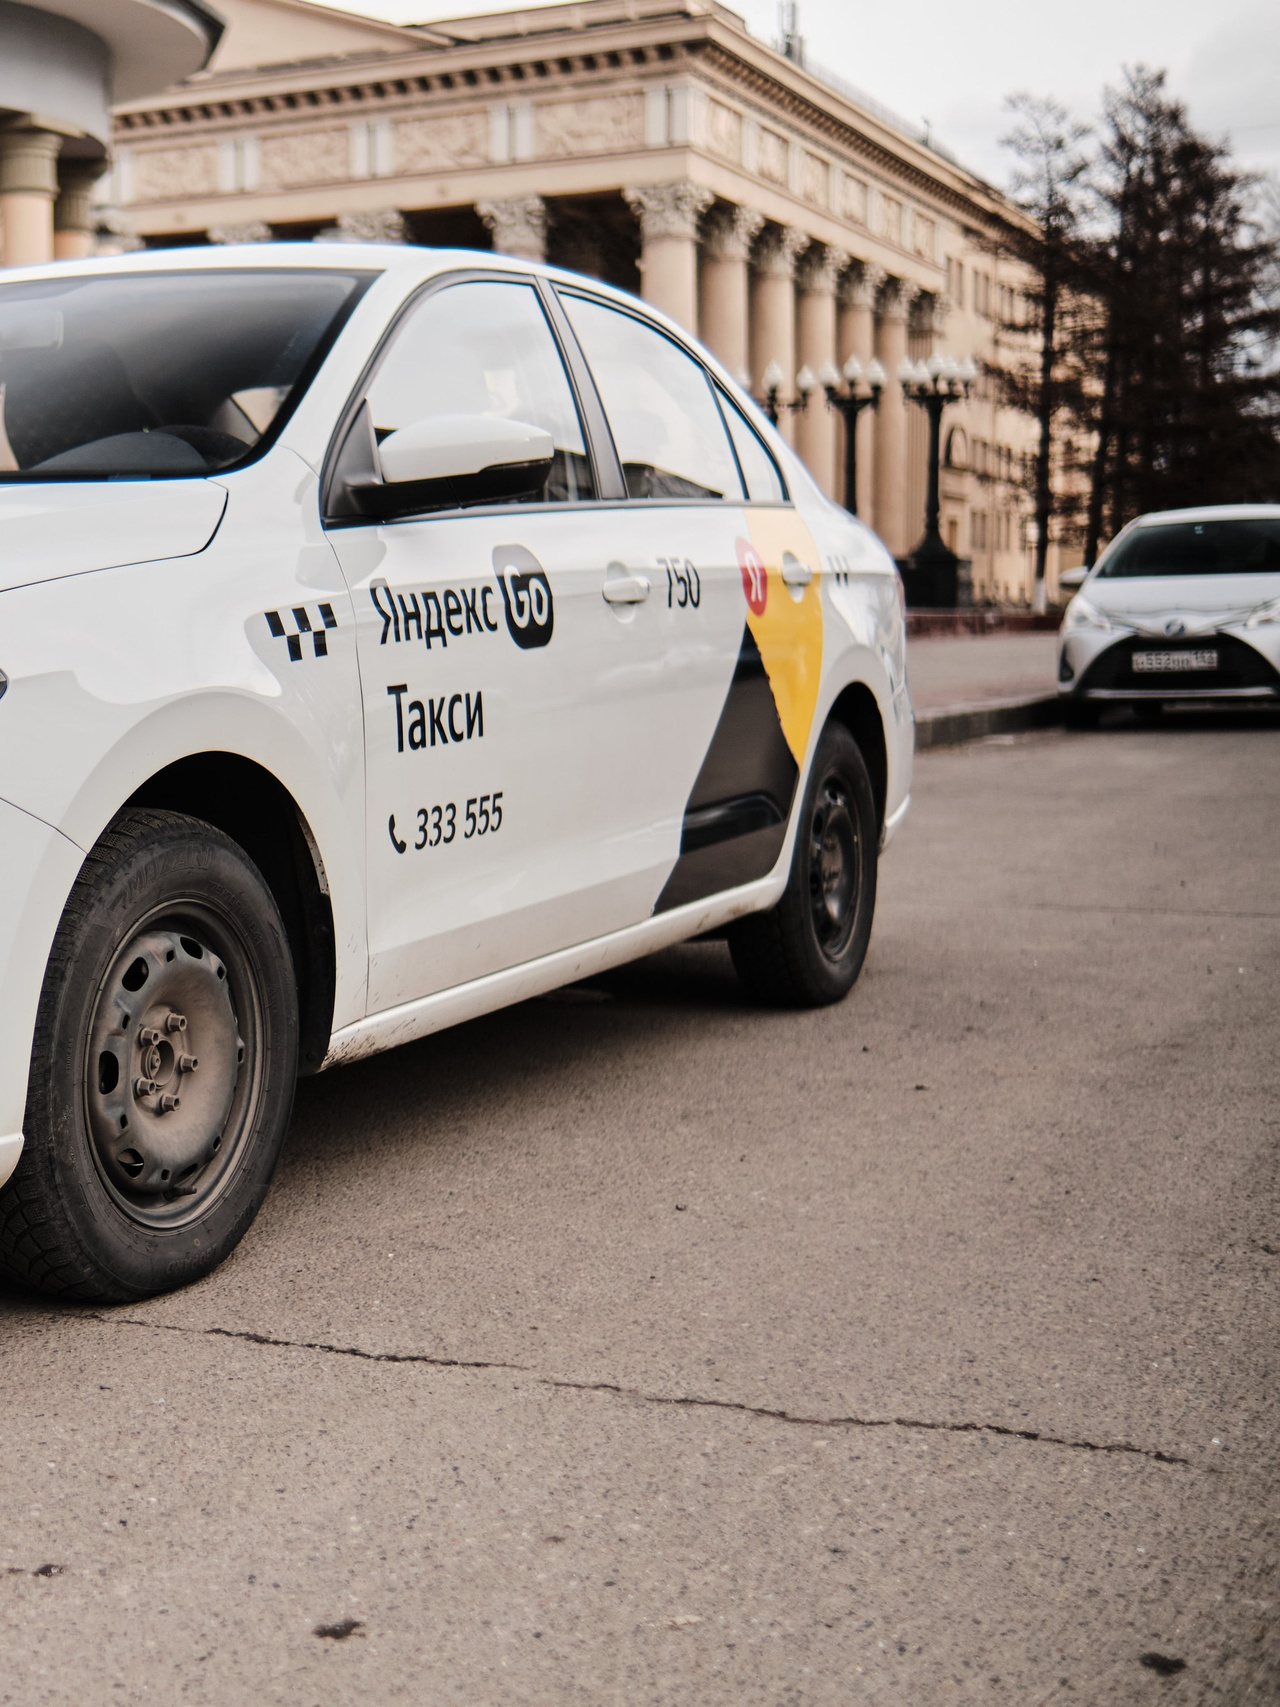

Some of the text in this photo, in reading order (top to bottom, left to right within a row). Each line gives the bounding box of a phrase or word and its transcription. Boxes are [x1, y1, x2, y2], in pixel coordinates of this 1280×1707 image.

[369, 564, 549, 649] Яндекс Go
[656, 557, 700, 608] 750
[387, 683, 484, 753] Такси
[414, 791, 503, 850] 333 555
